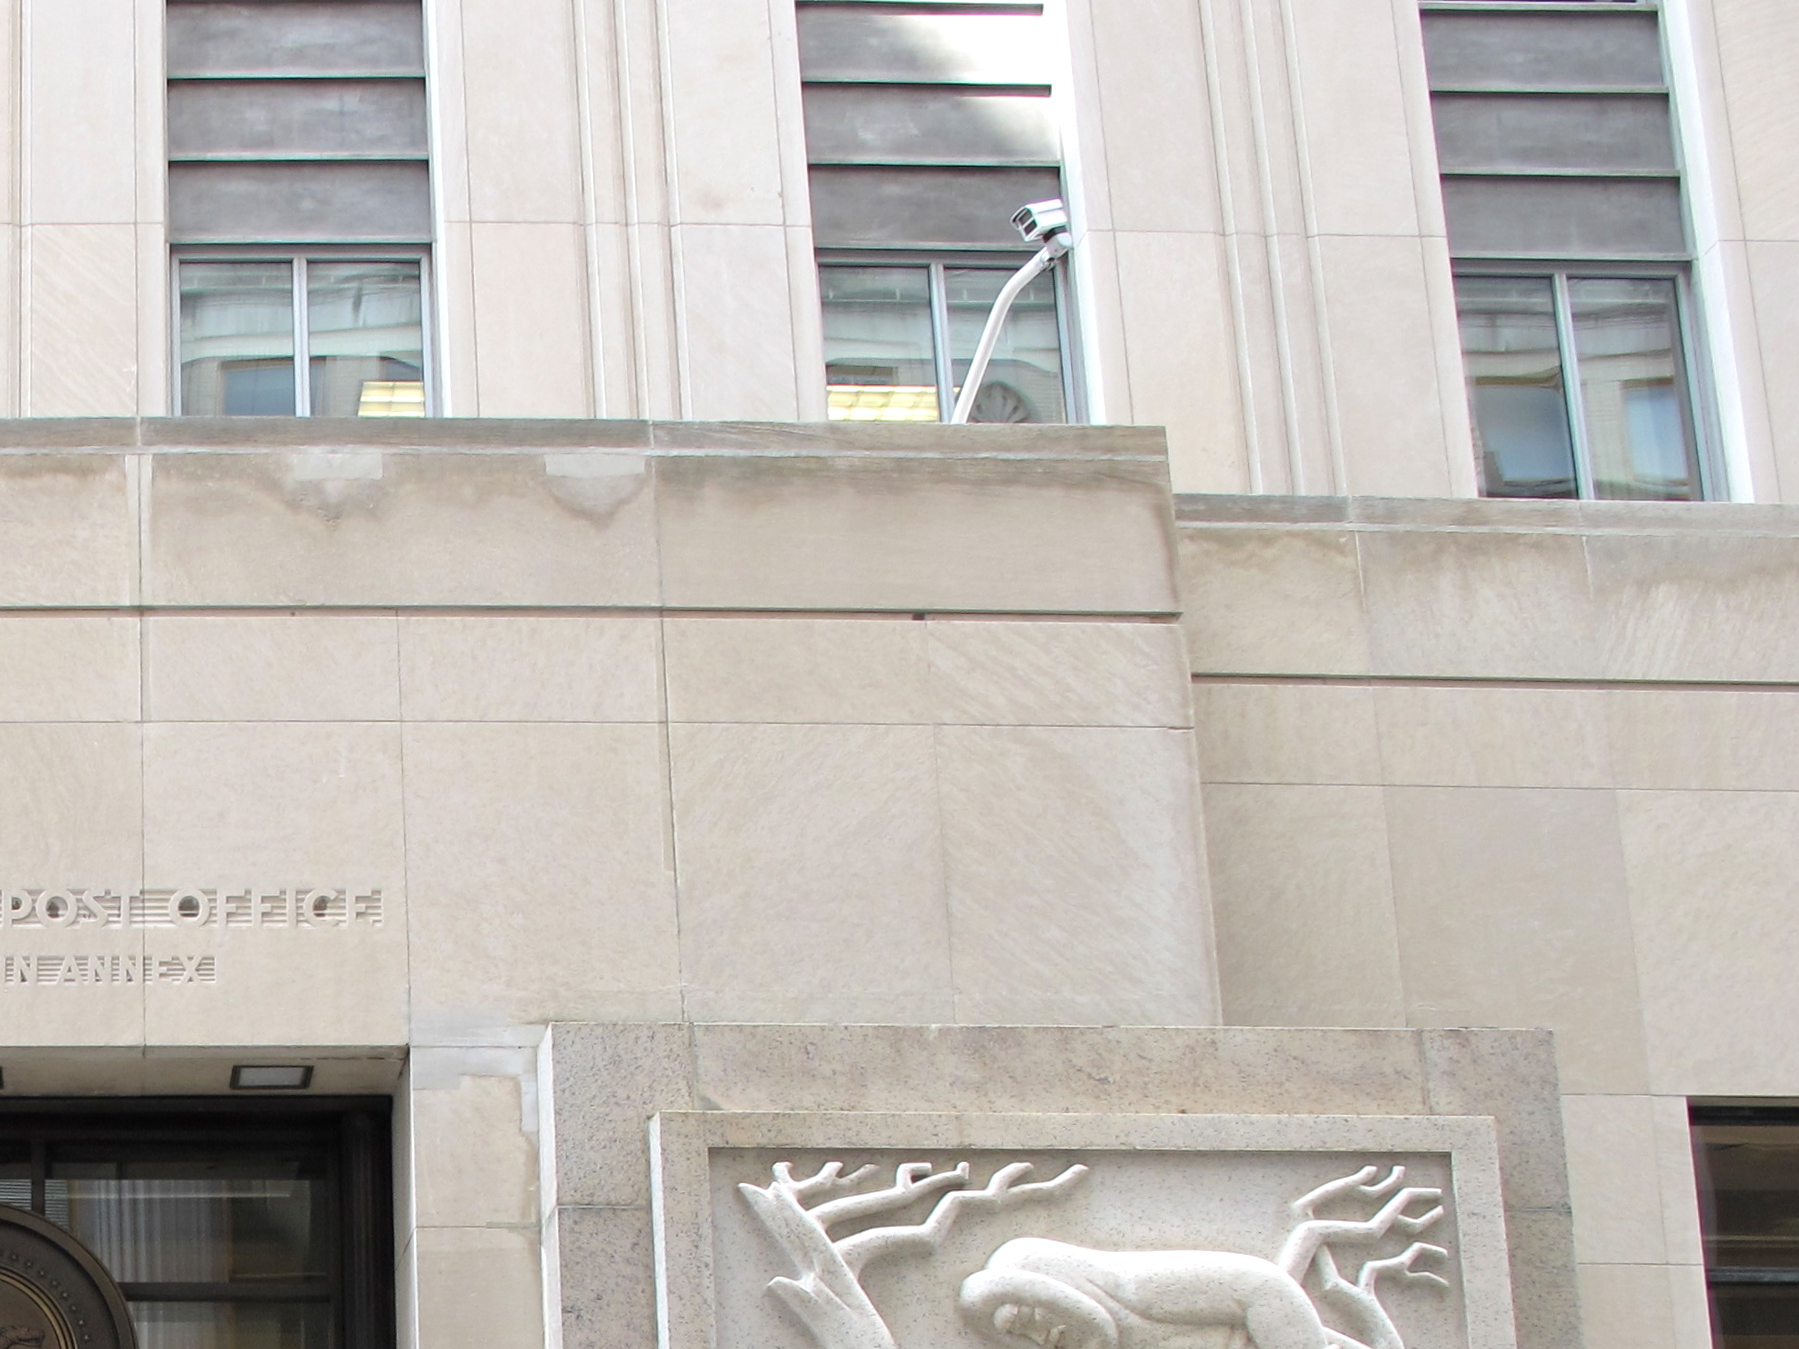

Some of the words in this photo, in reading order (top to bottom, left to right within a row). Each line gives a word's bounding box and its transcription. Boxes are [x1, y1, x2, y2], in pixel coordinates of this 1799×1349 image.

[2, 888, 142, 930] POST
[167, 888, 377, 930] OFFICE
[56, 954, 204, 985] ANNEX
